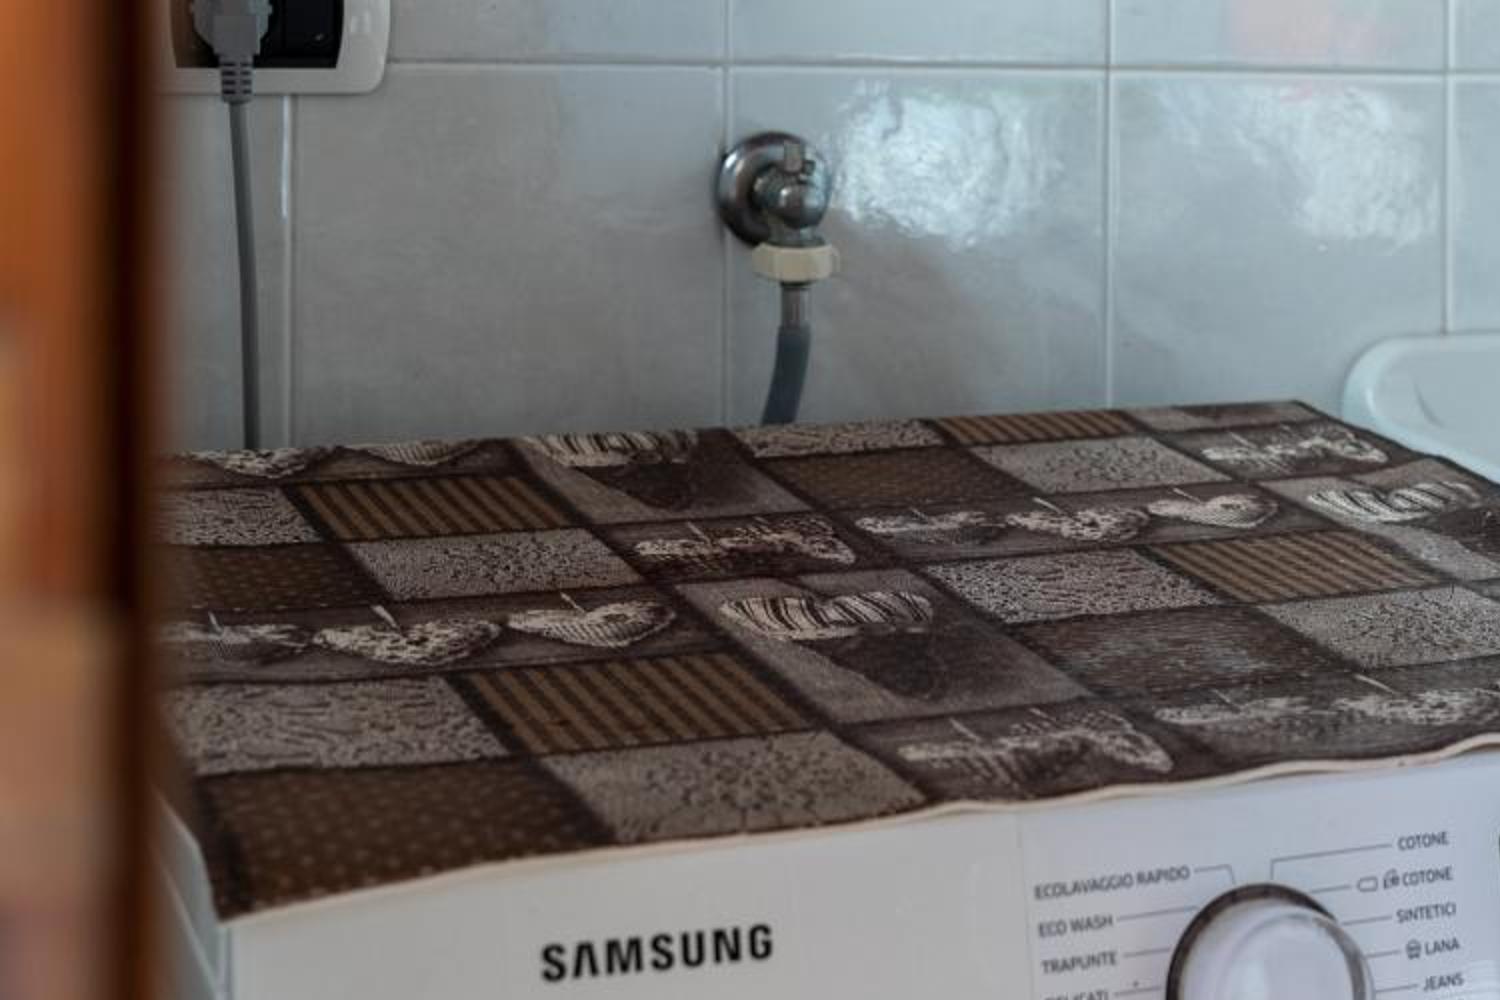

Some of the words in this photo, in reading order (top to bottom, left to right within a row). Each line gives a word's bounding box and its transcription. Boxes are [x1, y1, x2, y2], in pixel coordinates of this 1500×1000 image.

[1397, 831, 1450, 851] COTONE
[1035, 873, 1134, 899] ECOLAVAGGIO
[1136, 865, 1191, 885] RAPIDO
[1402, 865, 1454, 887] COTONE
[1396, 901, 1457, 924] SINTETICI
[1038, 919, 1067, 937] ECO
[1070, 914, 1114, 933] WASH
[540, 923, 774, 983] SAMSUNG
[1425, 937, 1460, 955] LANA
[1042, 950, 1117, 974] TRAPUNTE
[1424, 972, 1464, 992] JEANS
